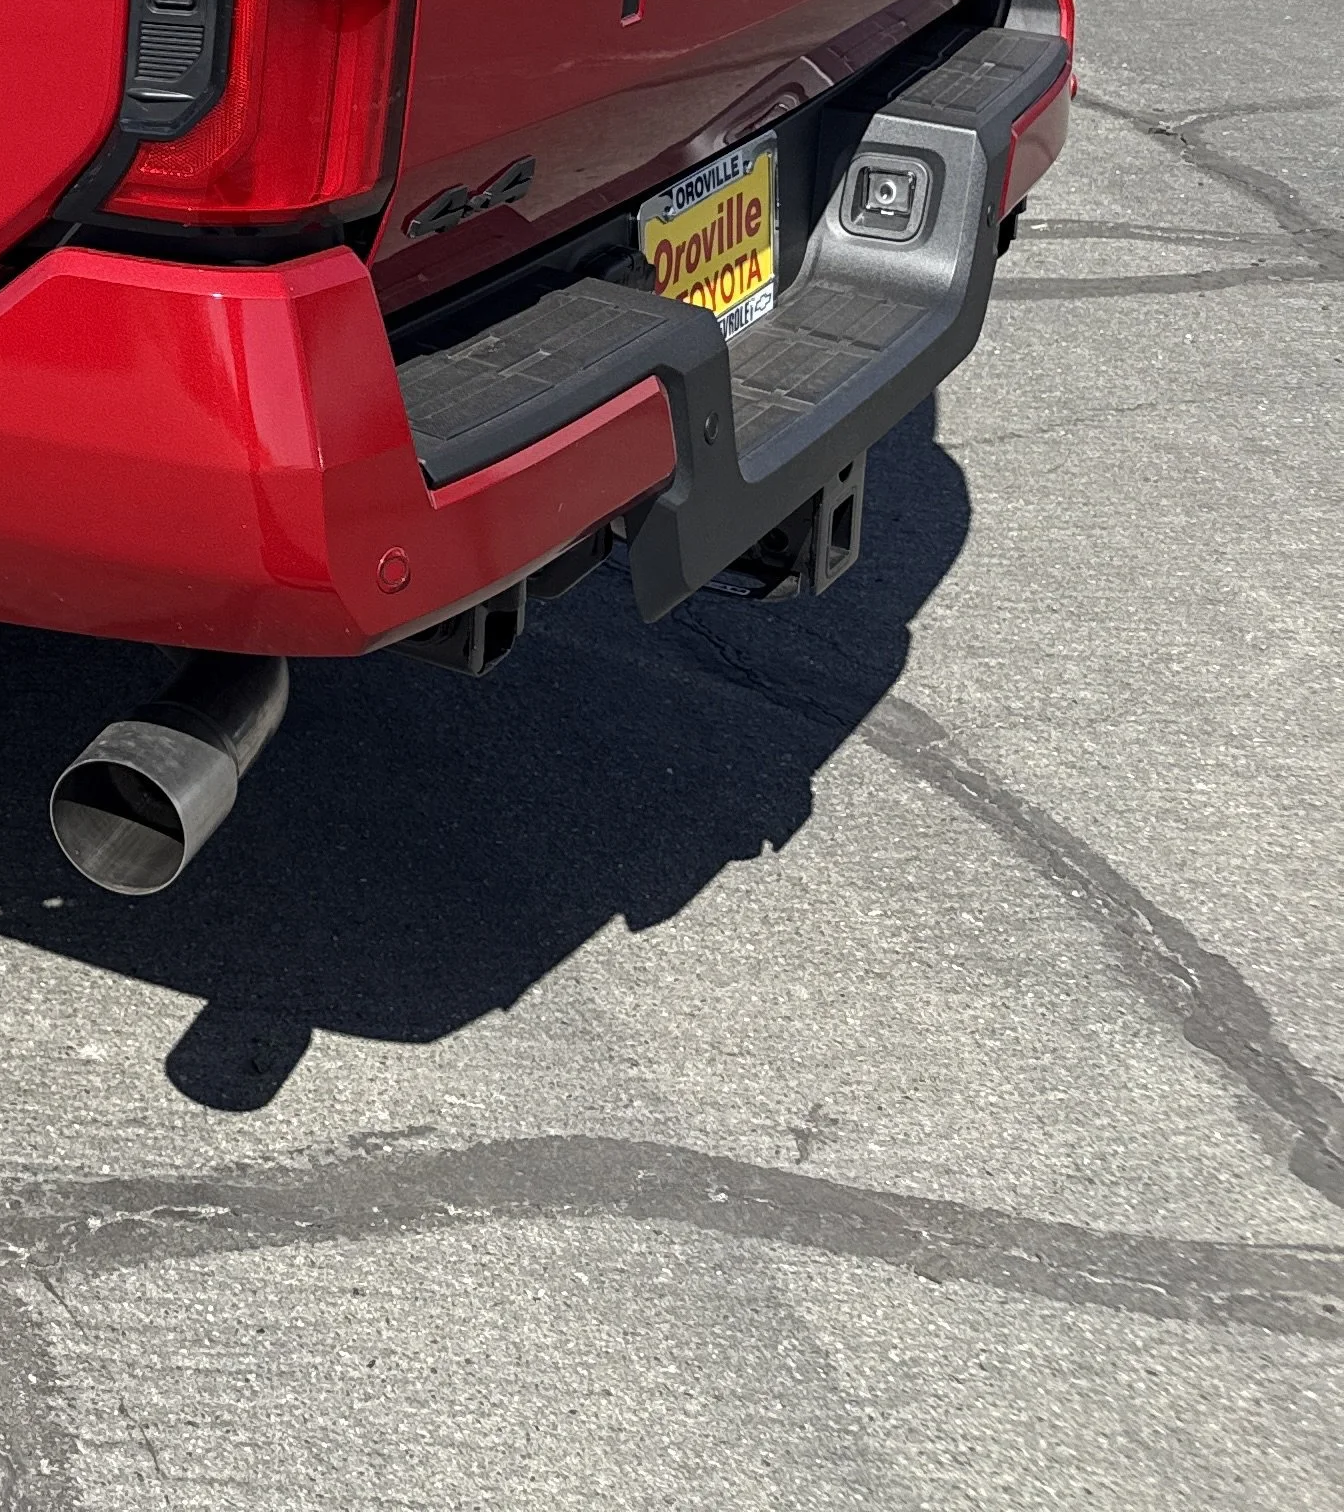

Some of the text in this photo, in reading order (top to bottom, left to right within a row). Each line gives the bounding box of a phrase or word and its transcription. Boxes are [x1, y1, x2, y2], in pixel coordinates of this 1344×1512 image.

[675, 154, 740, 210] OROVILLE
[653, 192, 762, 296] Oroville
[720, 298, 756, 338] VROLET
